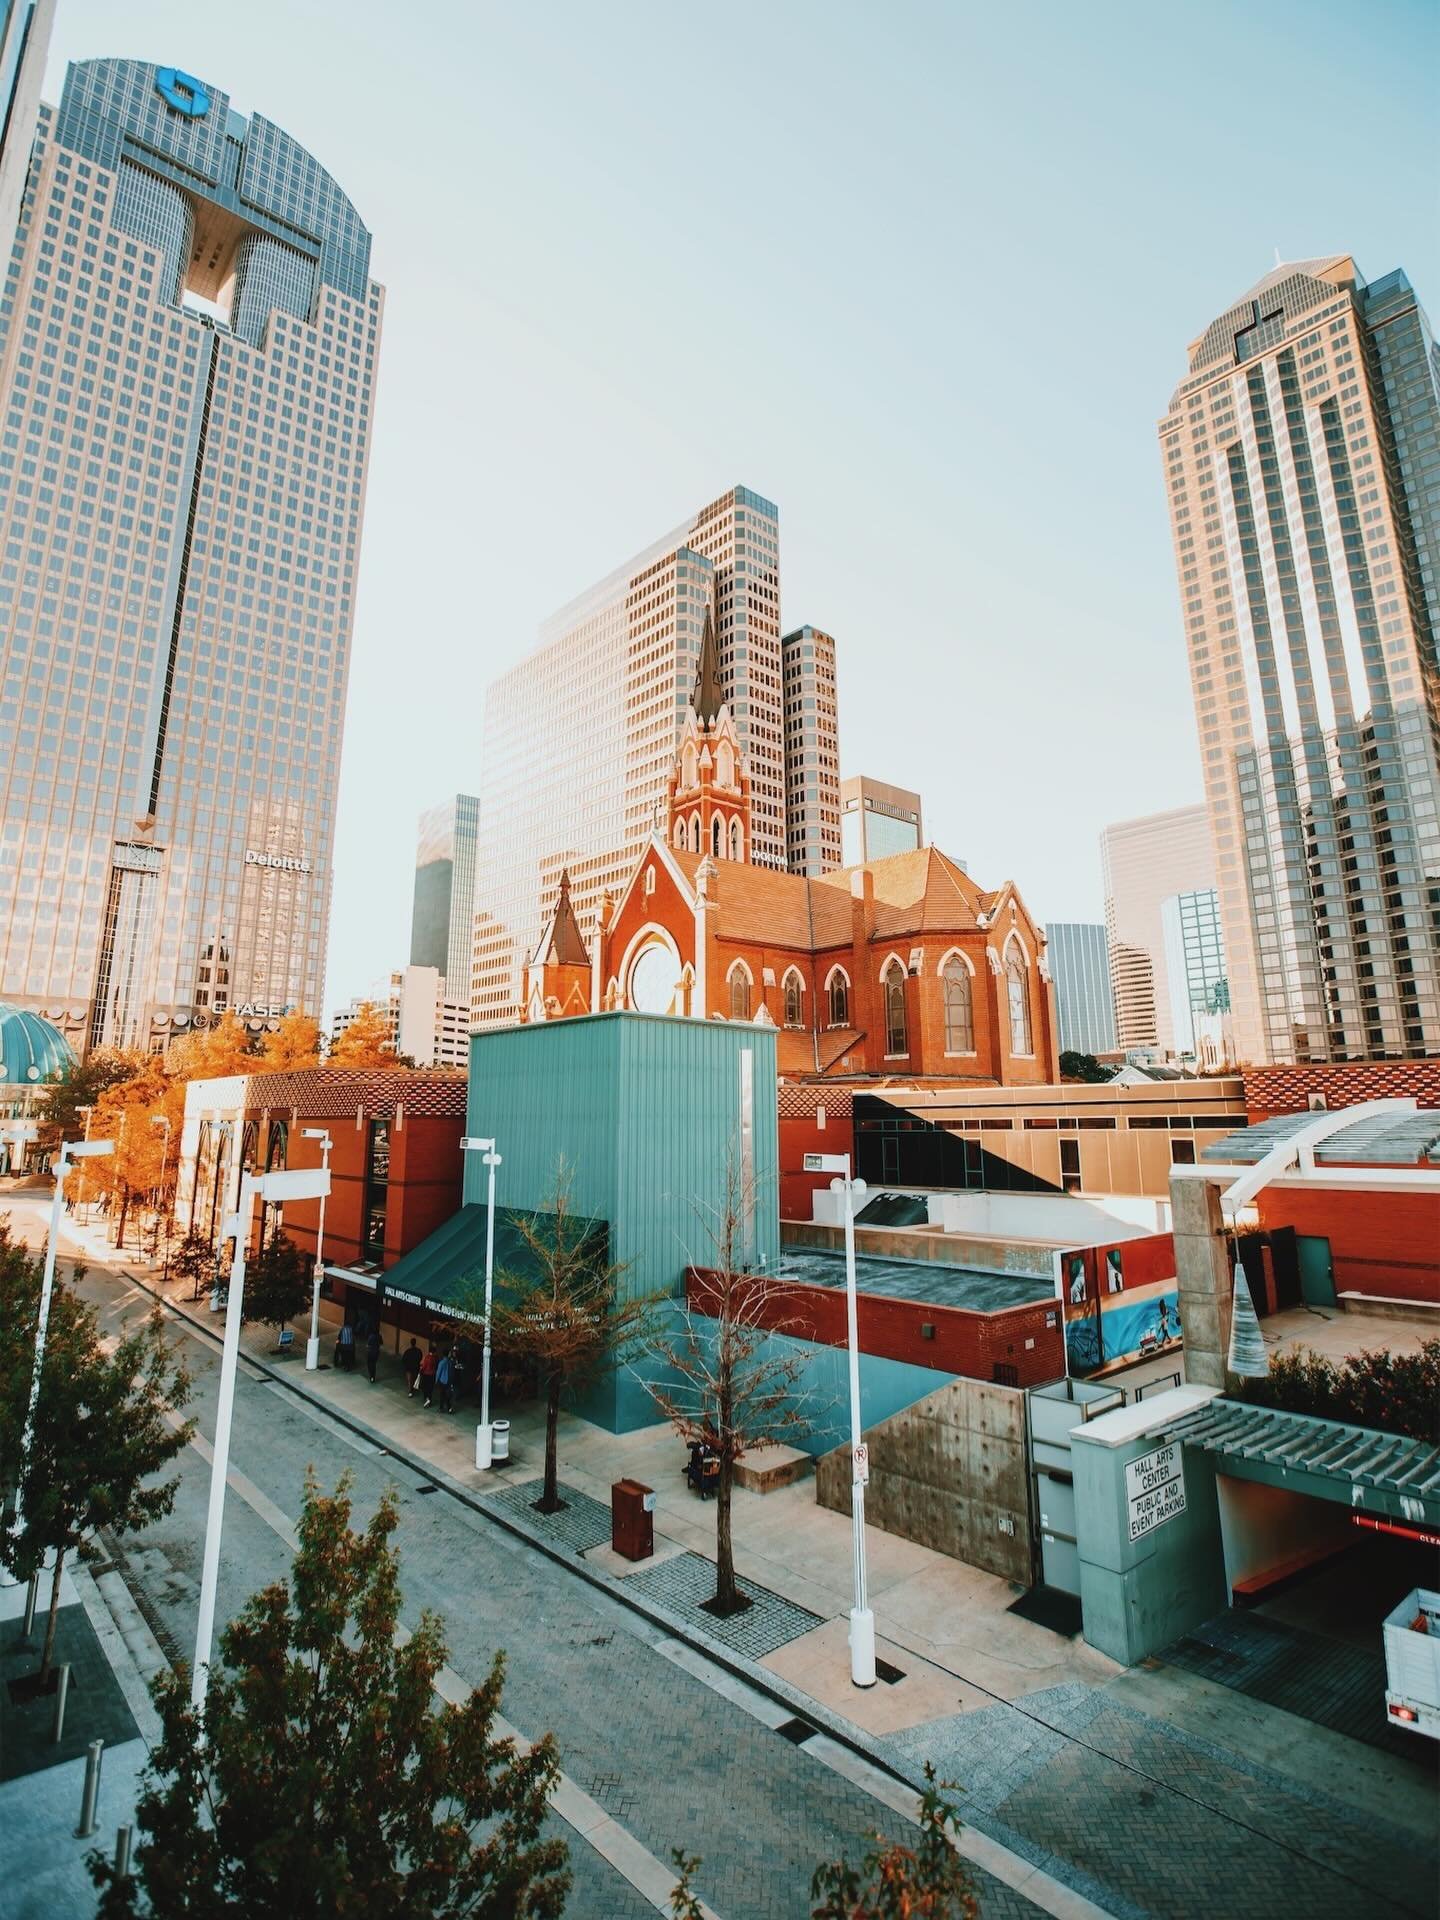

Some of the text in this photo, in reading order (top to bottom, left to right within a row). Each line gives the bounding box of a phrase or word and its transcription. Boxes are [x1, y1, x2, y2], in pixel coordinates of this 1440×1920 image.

[246, 849, 311, 872] Deloitte
[212, 1001, 281, 1018] CHASE
[425, 1299, 441, 1313] PUBLIC
[1134, 1447, 1174, 1478] HALL ARTS
[1142, 1465, 1170, 1489] CENTER
[1136, 1483, 1178, 1516] PUBLIC AND
[1131, 1494, 1185, 1535] EVENT PARKING
